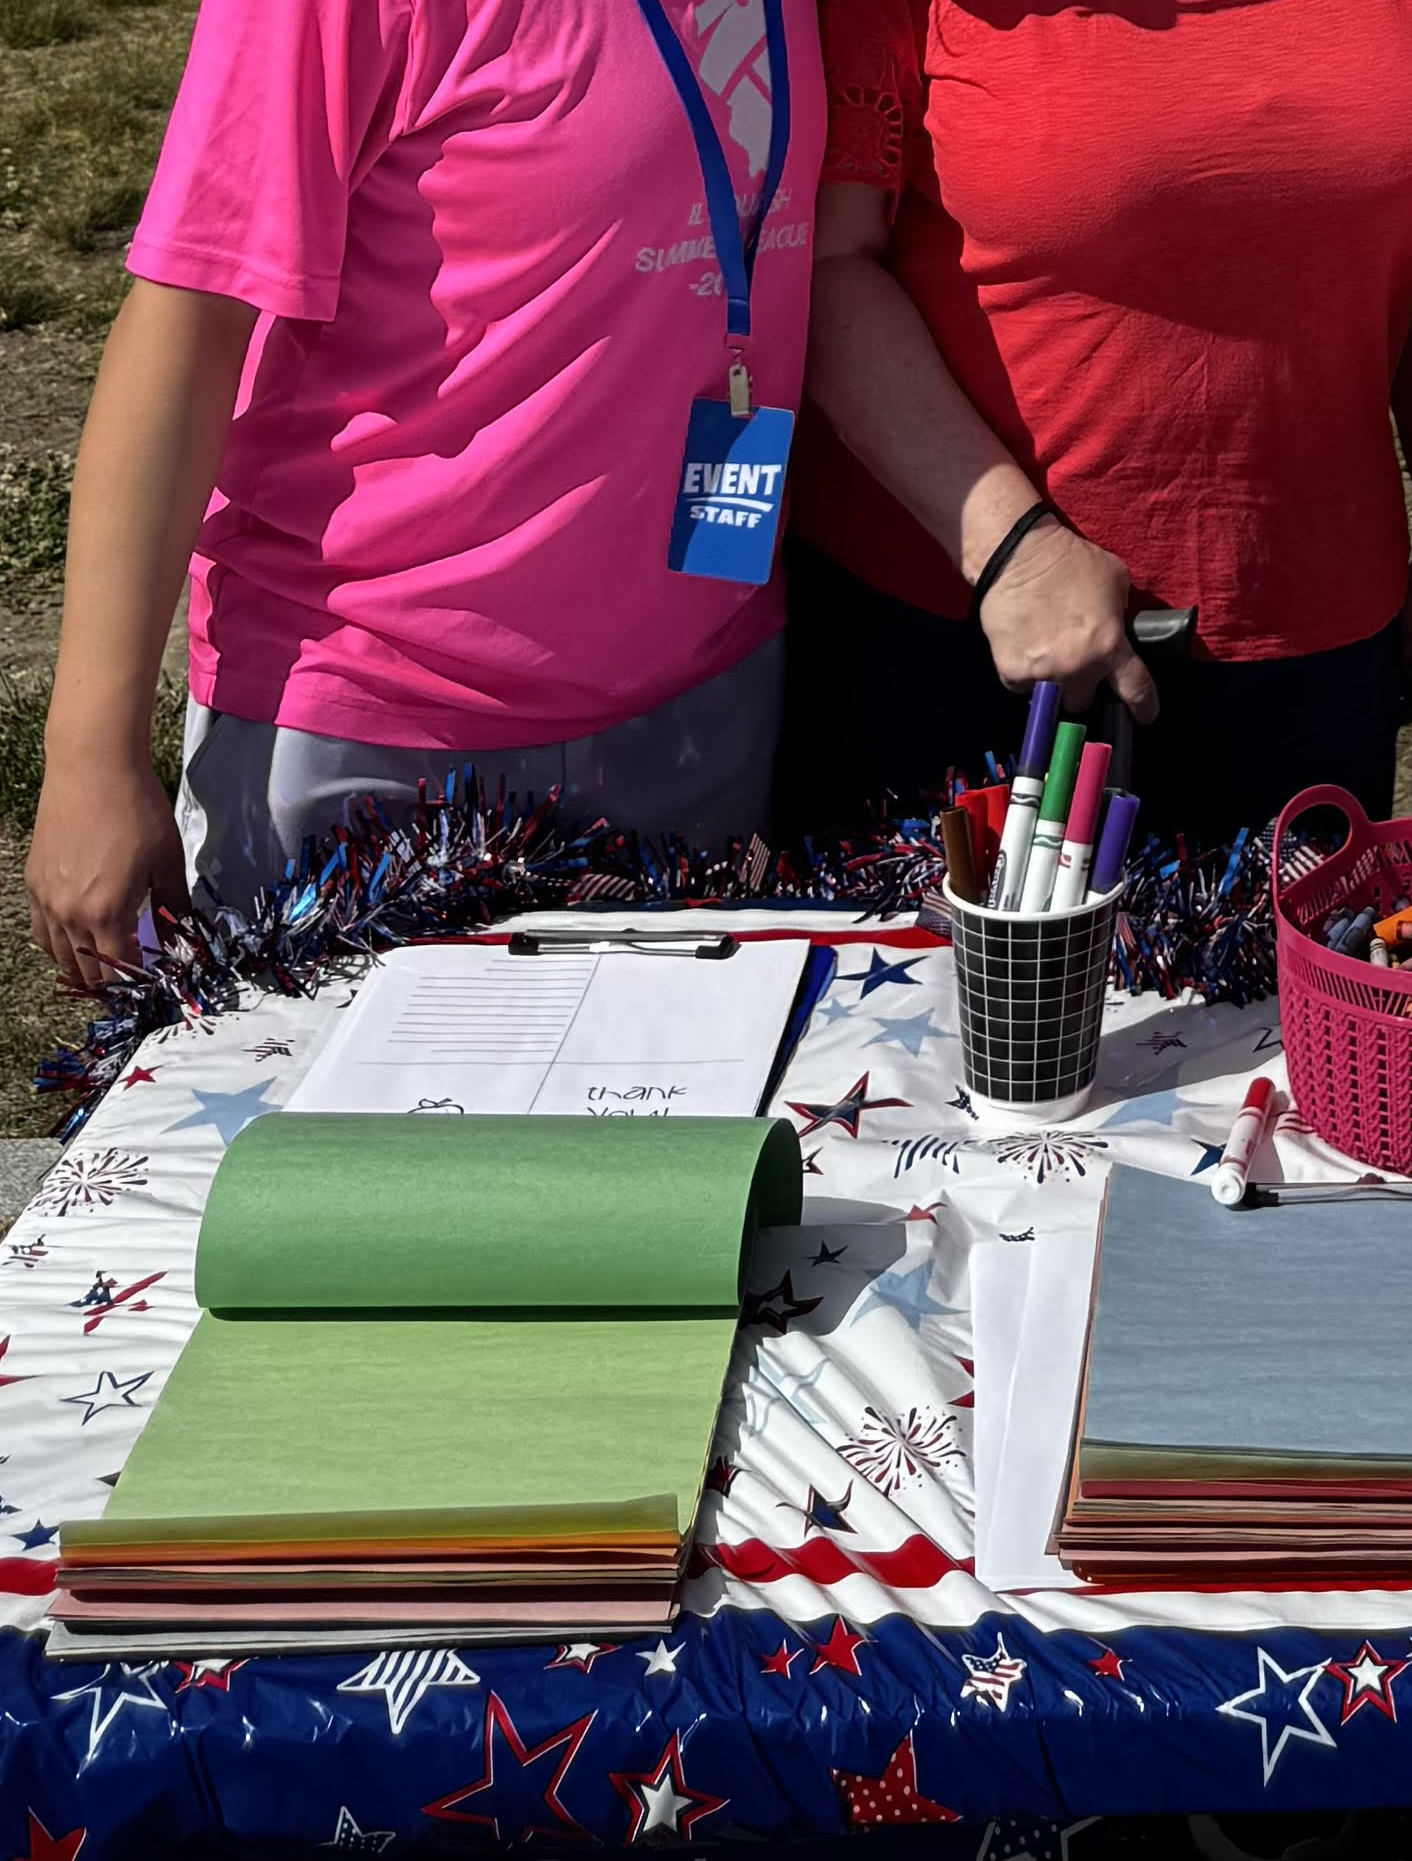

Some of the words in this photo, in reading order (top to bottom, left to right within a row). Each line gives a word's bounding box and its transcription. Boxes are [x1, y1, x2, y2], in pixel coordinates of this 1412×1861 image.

[683, 462, 782, 496] EVENT
[690, 505, 762, 528] STAFF
[587, 1085, 688, 1101] thank
